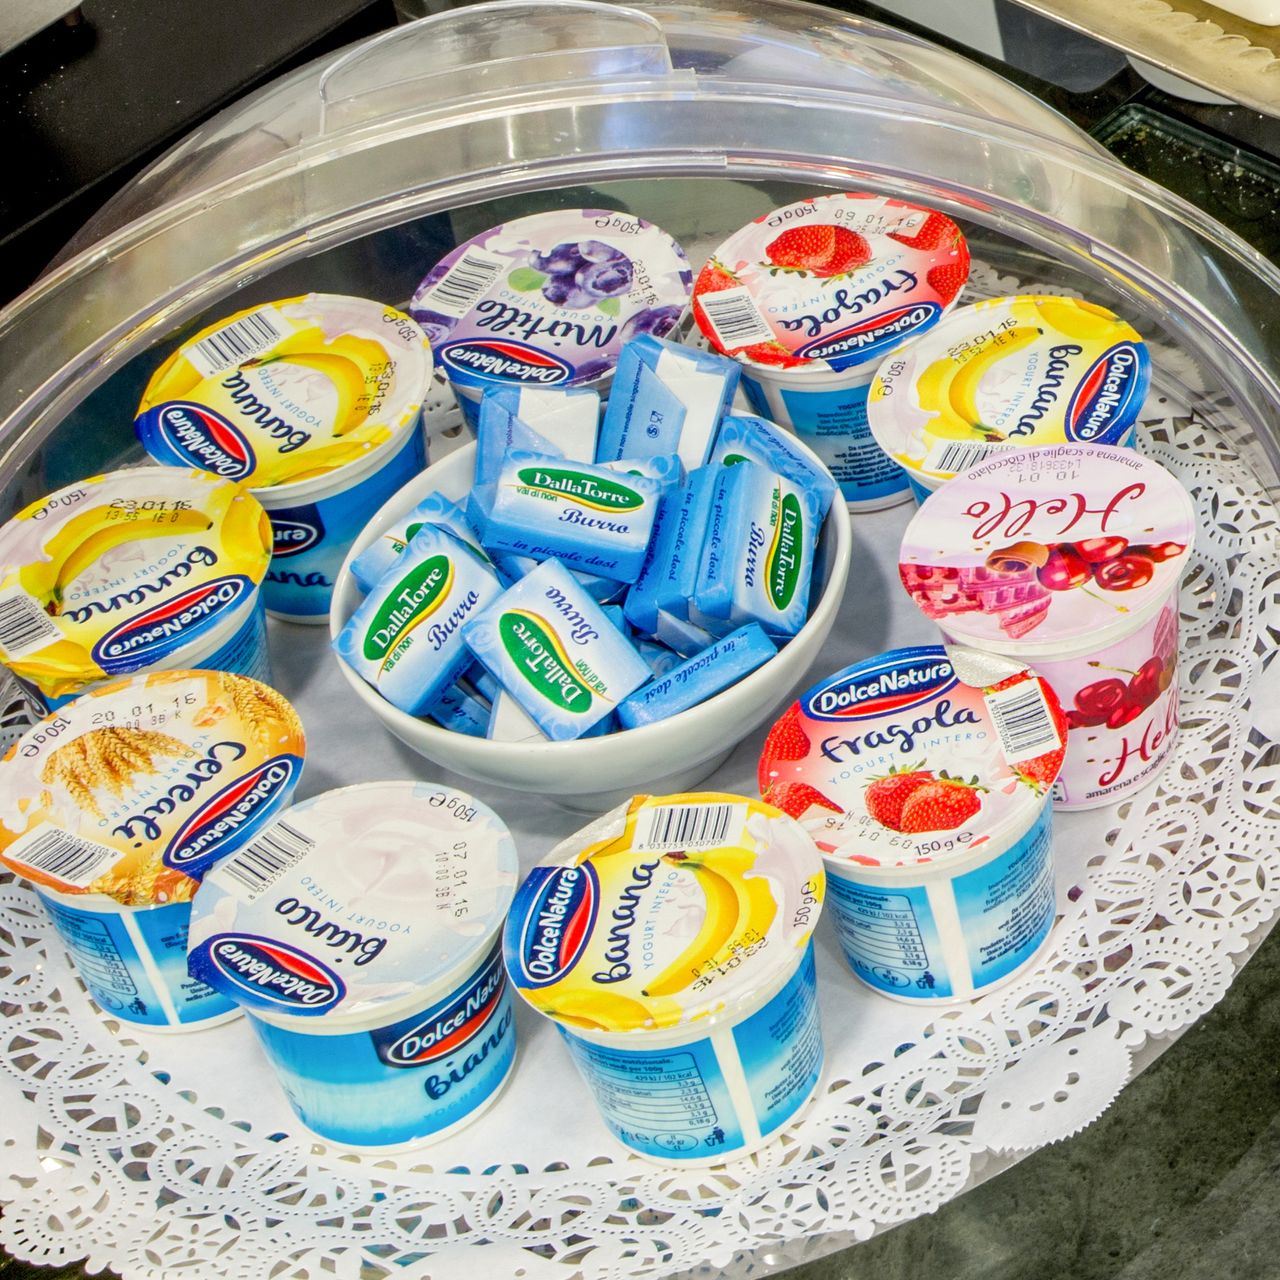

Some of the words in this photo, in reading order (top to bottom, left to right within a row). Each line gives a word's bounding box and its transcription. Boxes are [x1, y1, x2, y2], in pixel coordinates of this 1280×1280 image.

[476, 300, 618, 348] Mirtillo
[500, 290, 545, 312] INTERO
[806, 308, 927, 359] DolceNatura
[449, 347, 559, 382] DolceNatura
[1024, 351, 1040, 389] YOGURT
[995, 392, 1022, 426] INTERO
[1079, 354, 1131, 439] DolceNatura
[166, 409, 243, 476] DolceNatura
[1095, 450, 1143, 470] amarena
[533, 472, 630, 504] DallaTorre
[541, 491, 558, 502] non
[961, 482, 1145, 540] Hello
[558, 509, 630, 534] Burro
[675, 509, 690, 552] piccole
[711, 505, 724, 554] piccole
[530, 545, 583, 561] piccole
[745, 522, 766, 588] Burro
[776, 508, 797, 596] DallaTorre
[109, 583, 235, 656] DolceNatura
[371, 567, 443, 649] DallaTorre
[427, 591, 480, 651] Burro
[544, 585, 600, 646] Burro
[511, 621, 583, 706] DallaTorre
[821, 662, 951, 712] DolceNatura
[828, 753, 896, 786] YOGURT
[922, 730, 988, 750] INTERO
[112, 741, 246, 848] Cereali
[179, 765, 286, 858] DolceNatura
[1086, 778, 1132, 799] amarena
[300, 876, 338, 910] INTERO
[649, 871, 679, 916] INTERO
[347, 913, 412, 935] YOGURT
[643, 918, 656, 971] YOGURT
[218, 944, 332, 1003] DolceNatura
